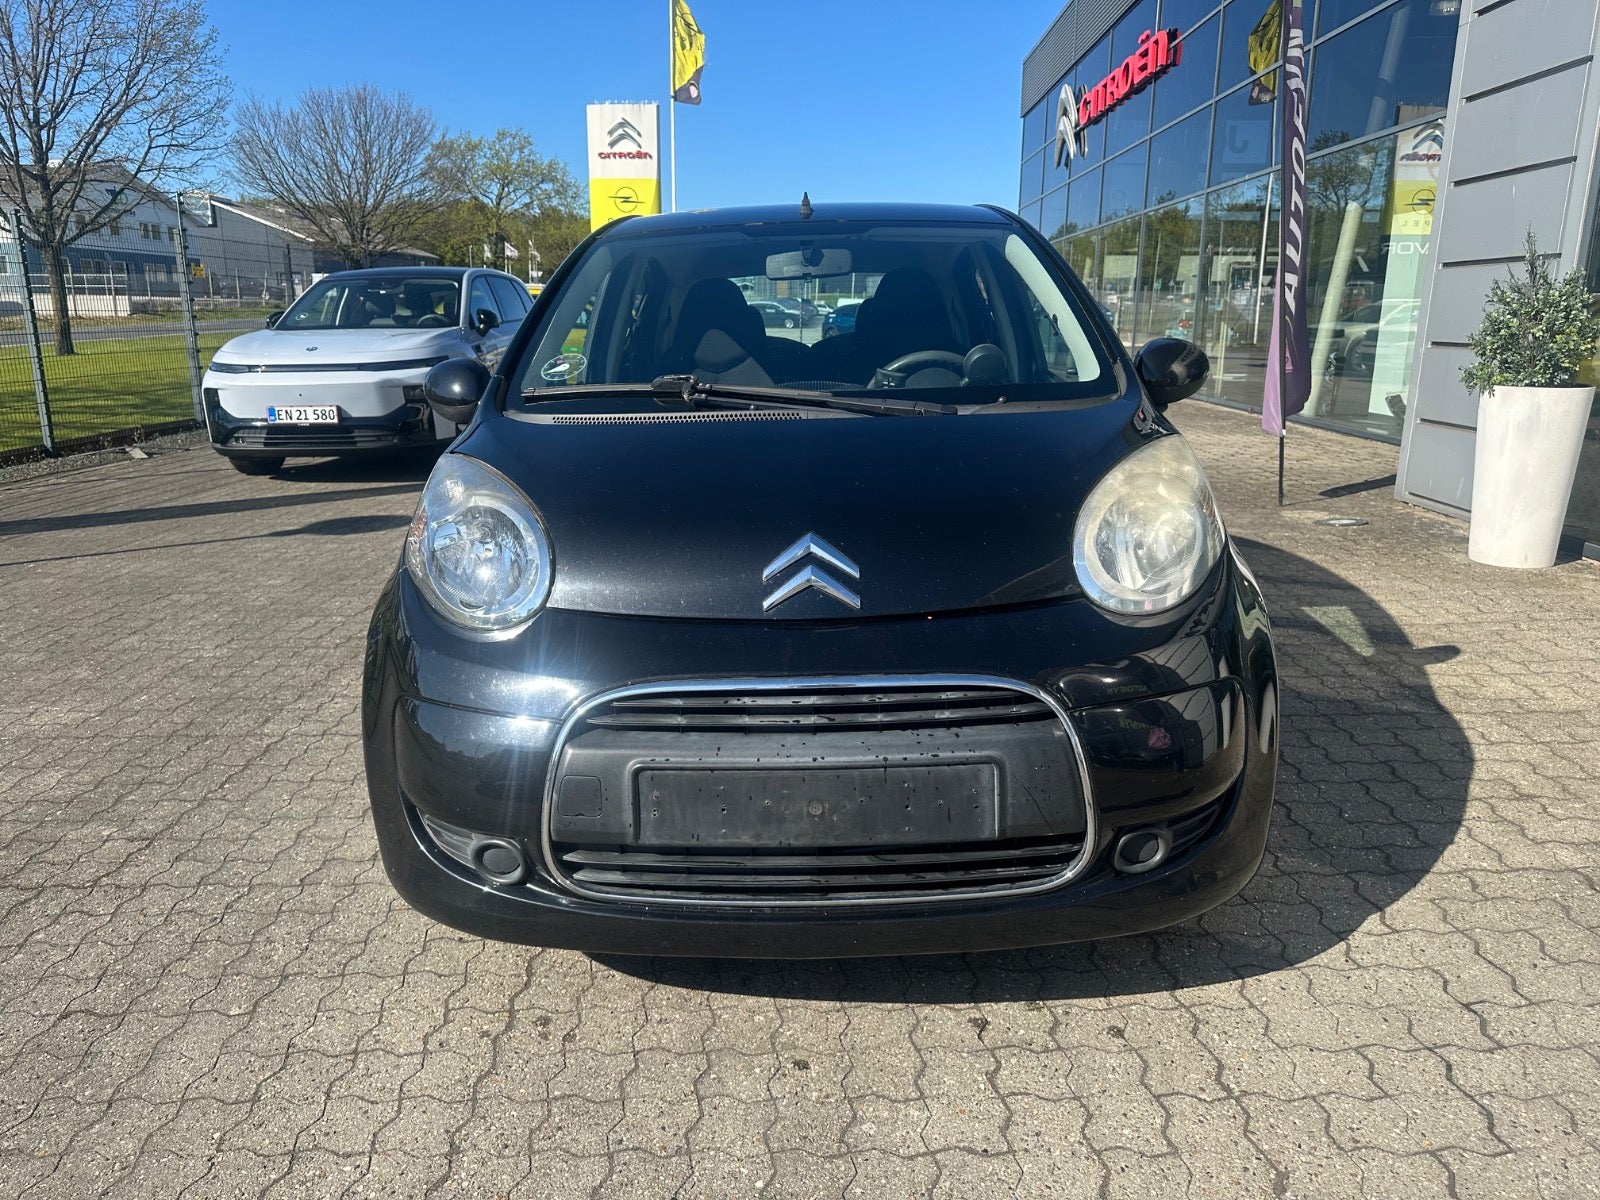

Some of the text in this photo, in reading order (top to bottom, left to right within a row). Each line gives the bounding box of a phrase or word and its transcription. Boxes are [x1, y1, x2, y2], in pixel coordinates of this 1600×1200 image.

[1079, 30, 1168, 126] CITROËN
[597, 150, 653, 160] CITROËN
[1284, 28, 1306, 316] AUTOFYN
[277, 409, 336, 421] EN 21 580
